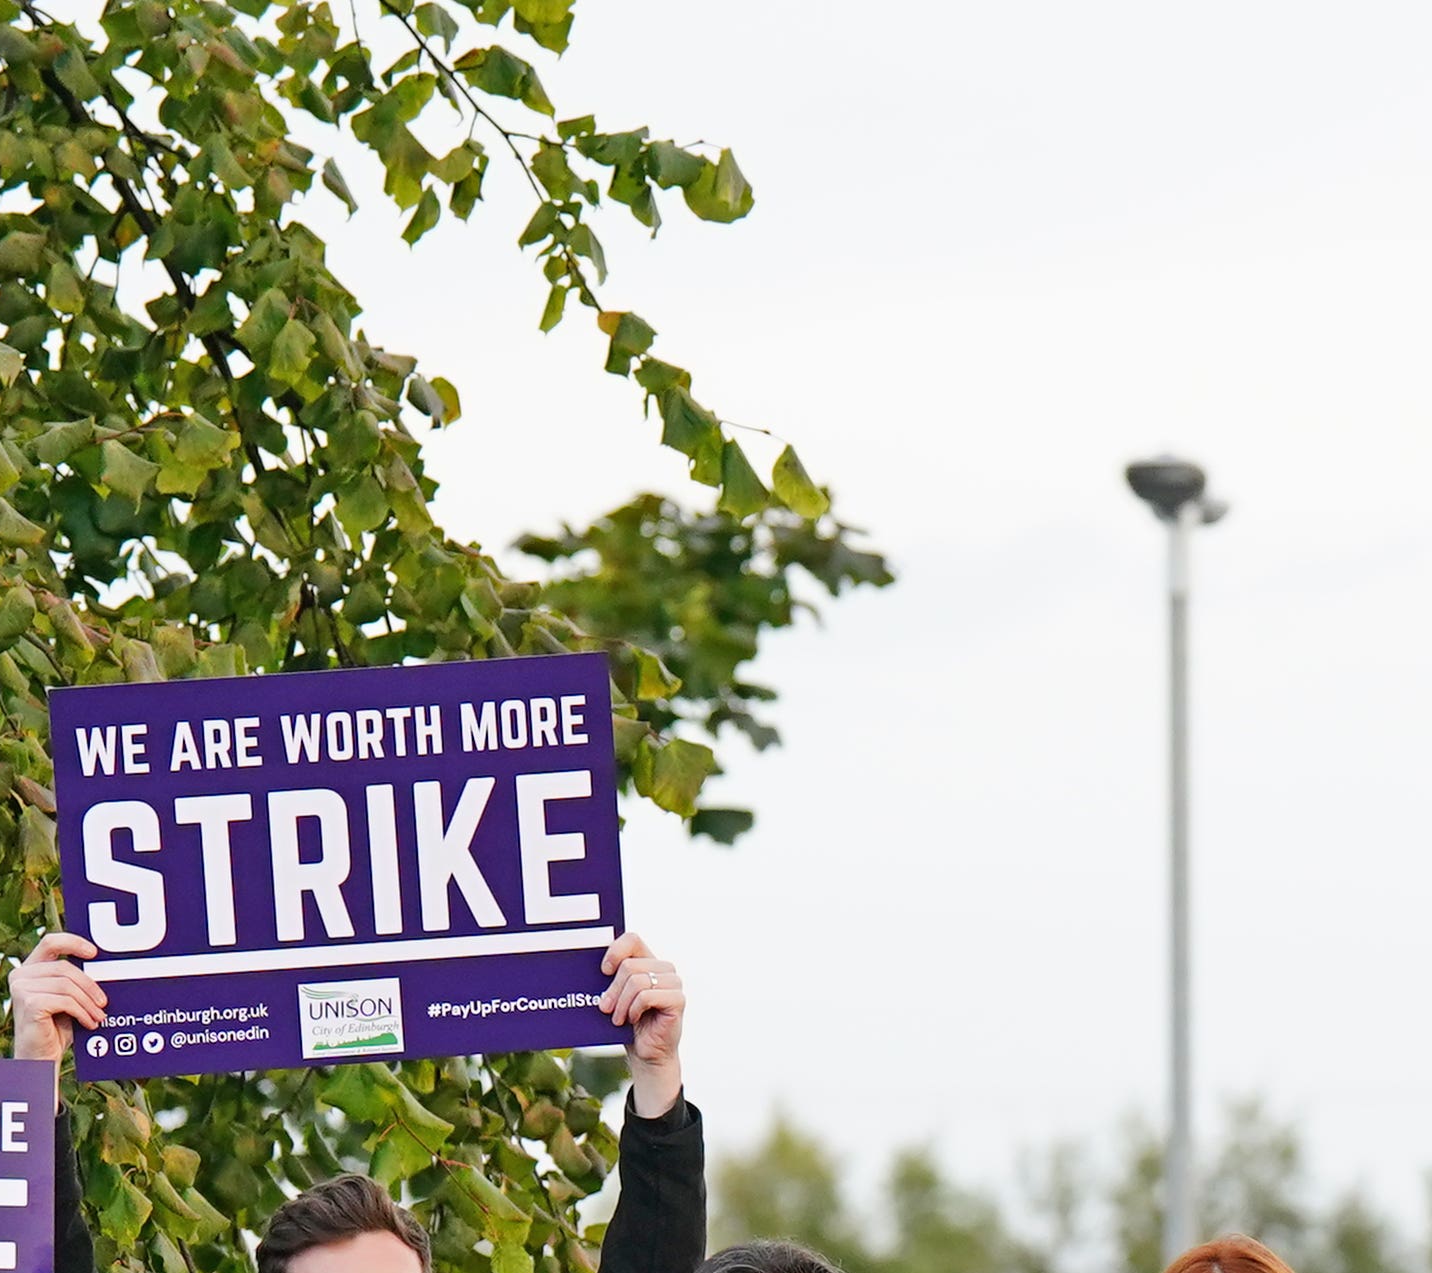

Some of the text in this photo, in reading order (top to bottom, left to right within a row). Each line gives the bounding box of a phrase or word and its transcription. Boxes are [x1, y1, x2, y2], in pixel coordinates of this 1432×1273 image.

[76, 695, 588, 776] WE ARE WORTH MORE
[83, 770, 600, 952] STRIKE
[310, 998, 391, 1020] UNISON
[427, 992, 604, 1019] #PayUpForCouncilSta
[171, 1026, 269, 1048] @unisonedin
[312, 1021, 399, 1037] City of Edinburgh
